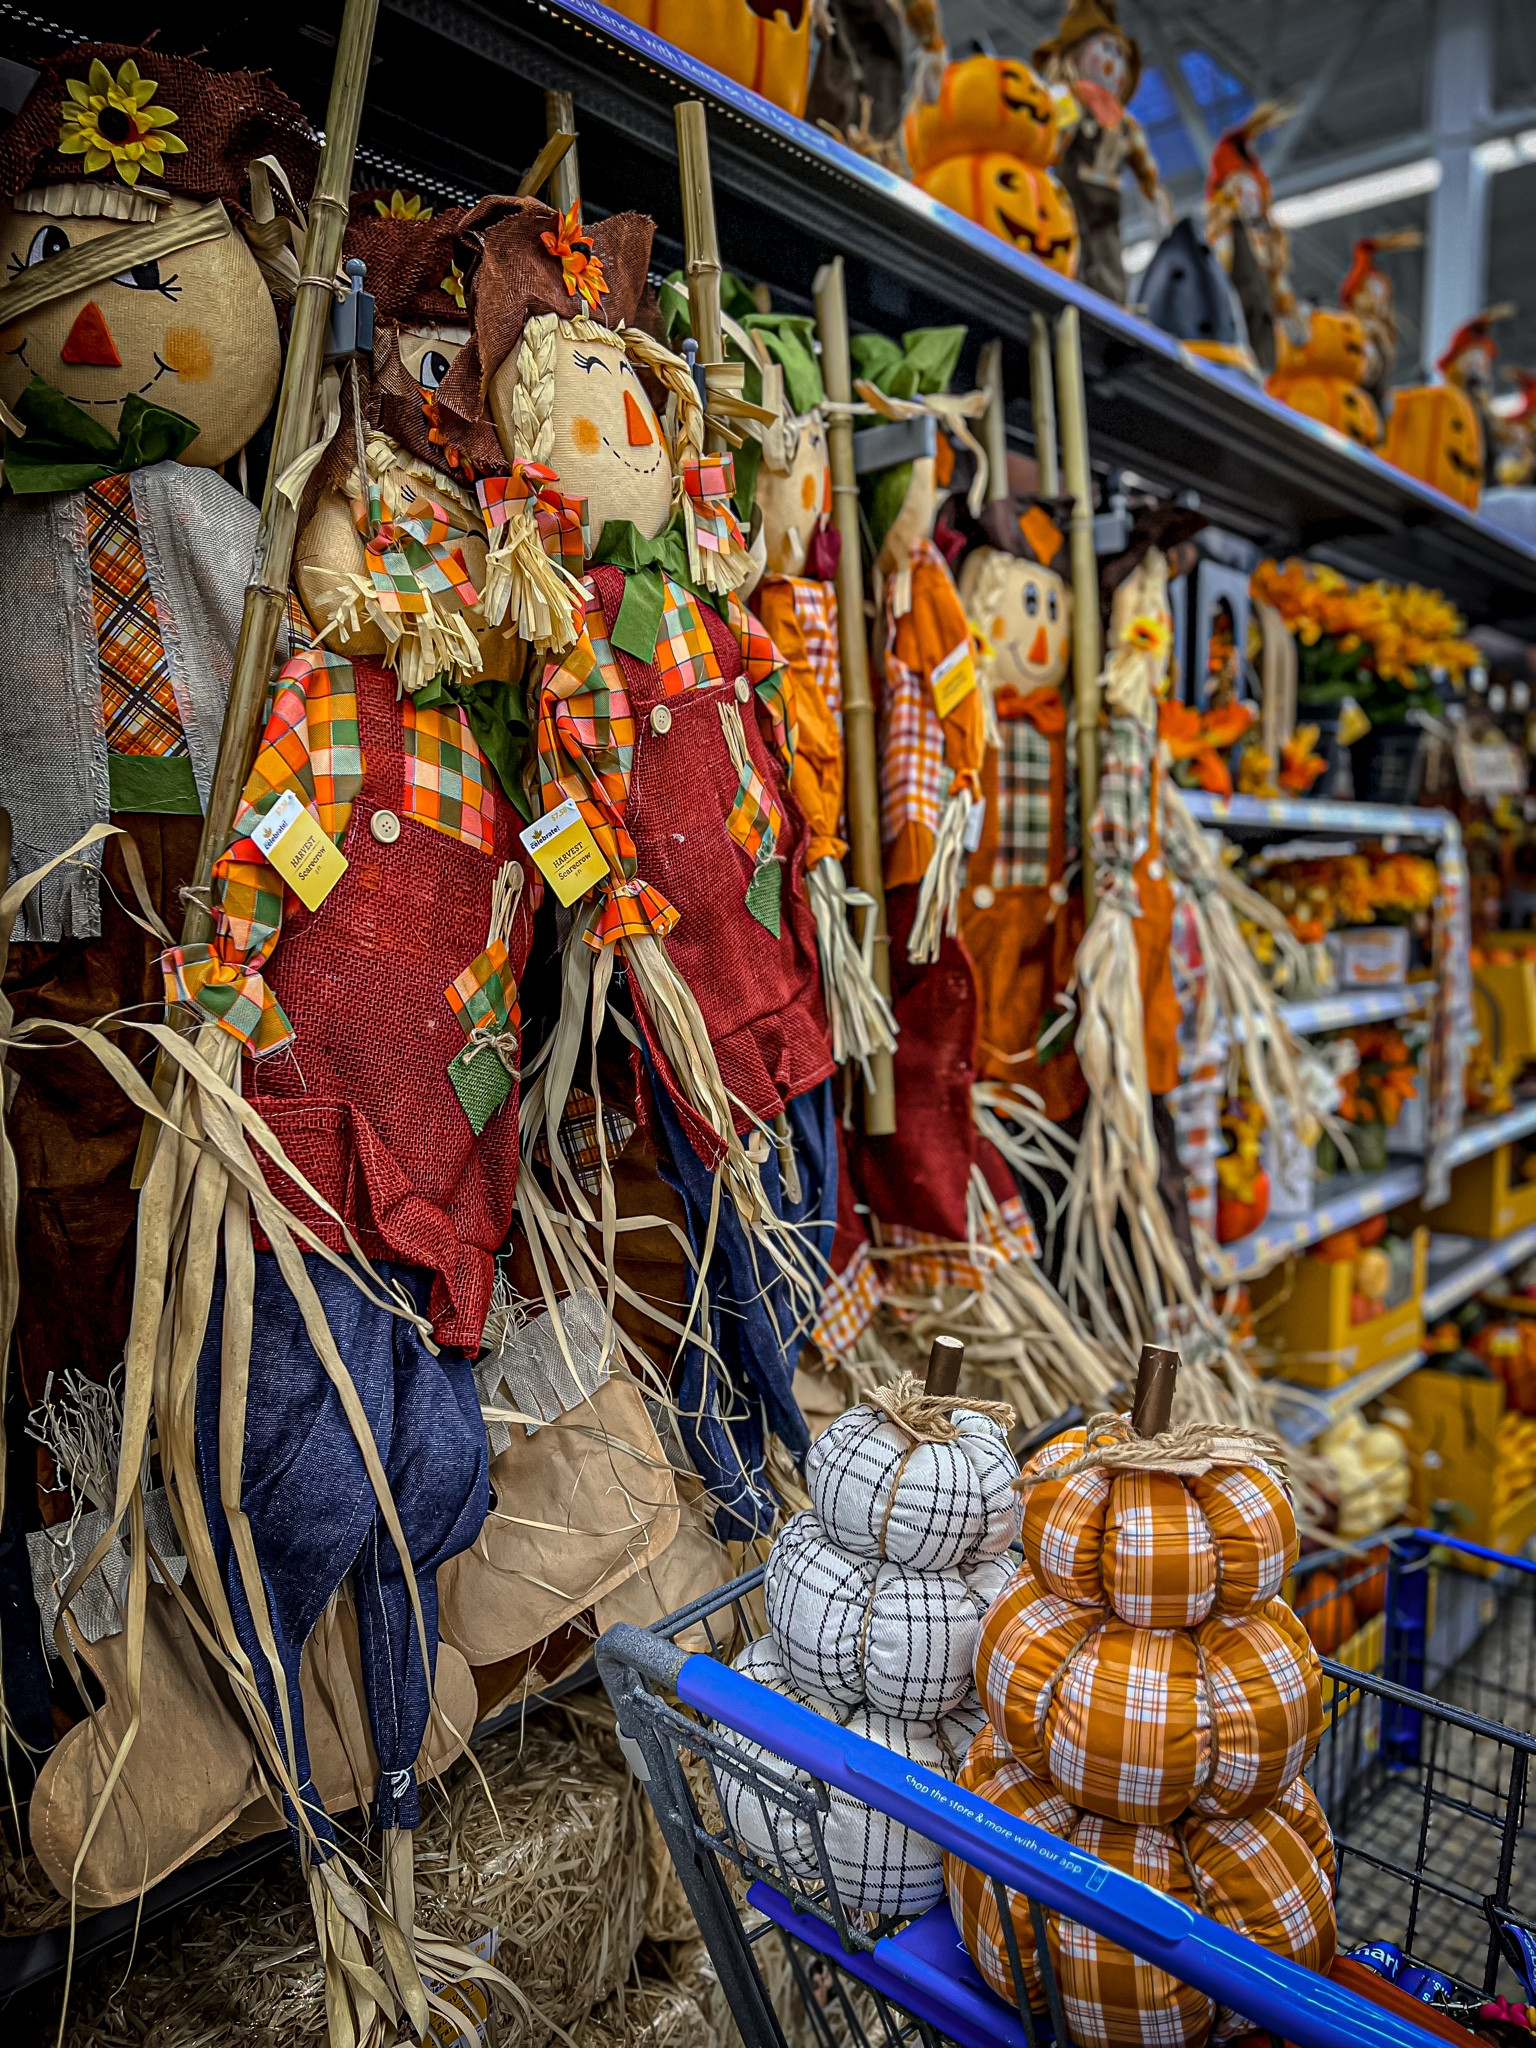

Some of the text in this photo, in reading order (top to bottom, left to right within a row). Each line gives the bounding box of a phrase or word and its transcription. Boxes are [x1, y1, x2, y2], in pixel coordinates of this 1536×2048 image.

[642, 35, 680, 64] with
[290, 835, 317, 868] HARVEST
[530, 824, 561, 850] celebrate!
[298, 845, 326, 881] Scarecrow
[552, 841, 583, 869] HARVEST
[558, 851, 592, 881] Scarecrow
[930, 1788, 948, 1803] the
[949, 1799, 975, 1818] store
[975, 1812, 984, 1823] &
[984, 1819, 1013, 1838] more
[1014, 1834, 1038, 1851] with
[1039, 1847, 1060, 1862] our
[1059, 1859, 1082, 1874] app
